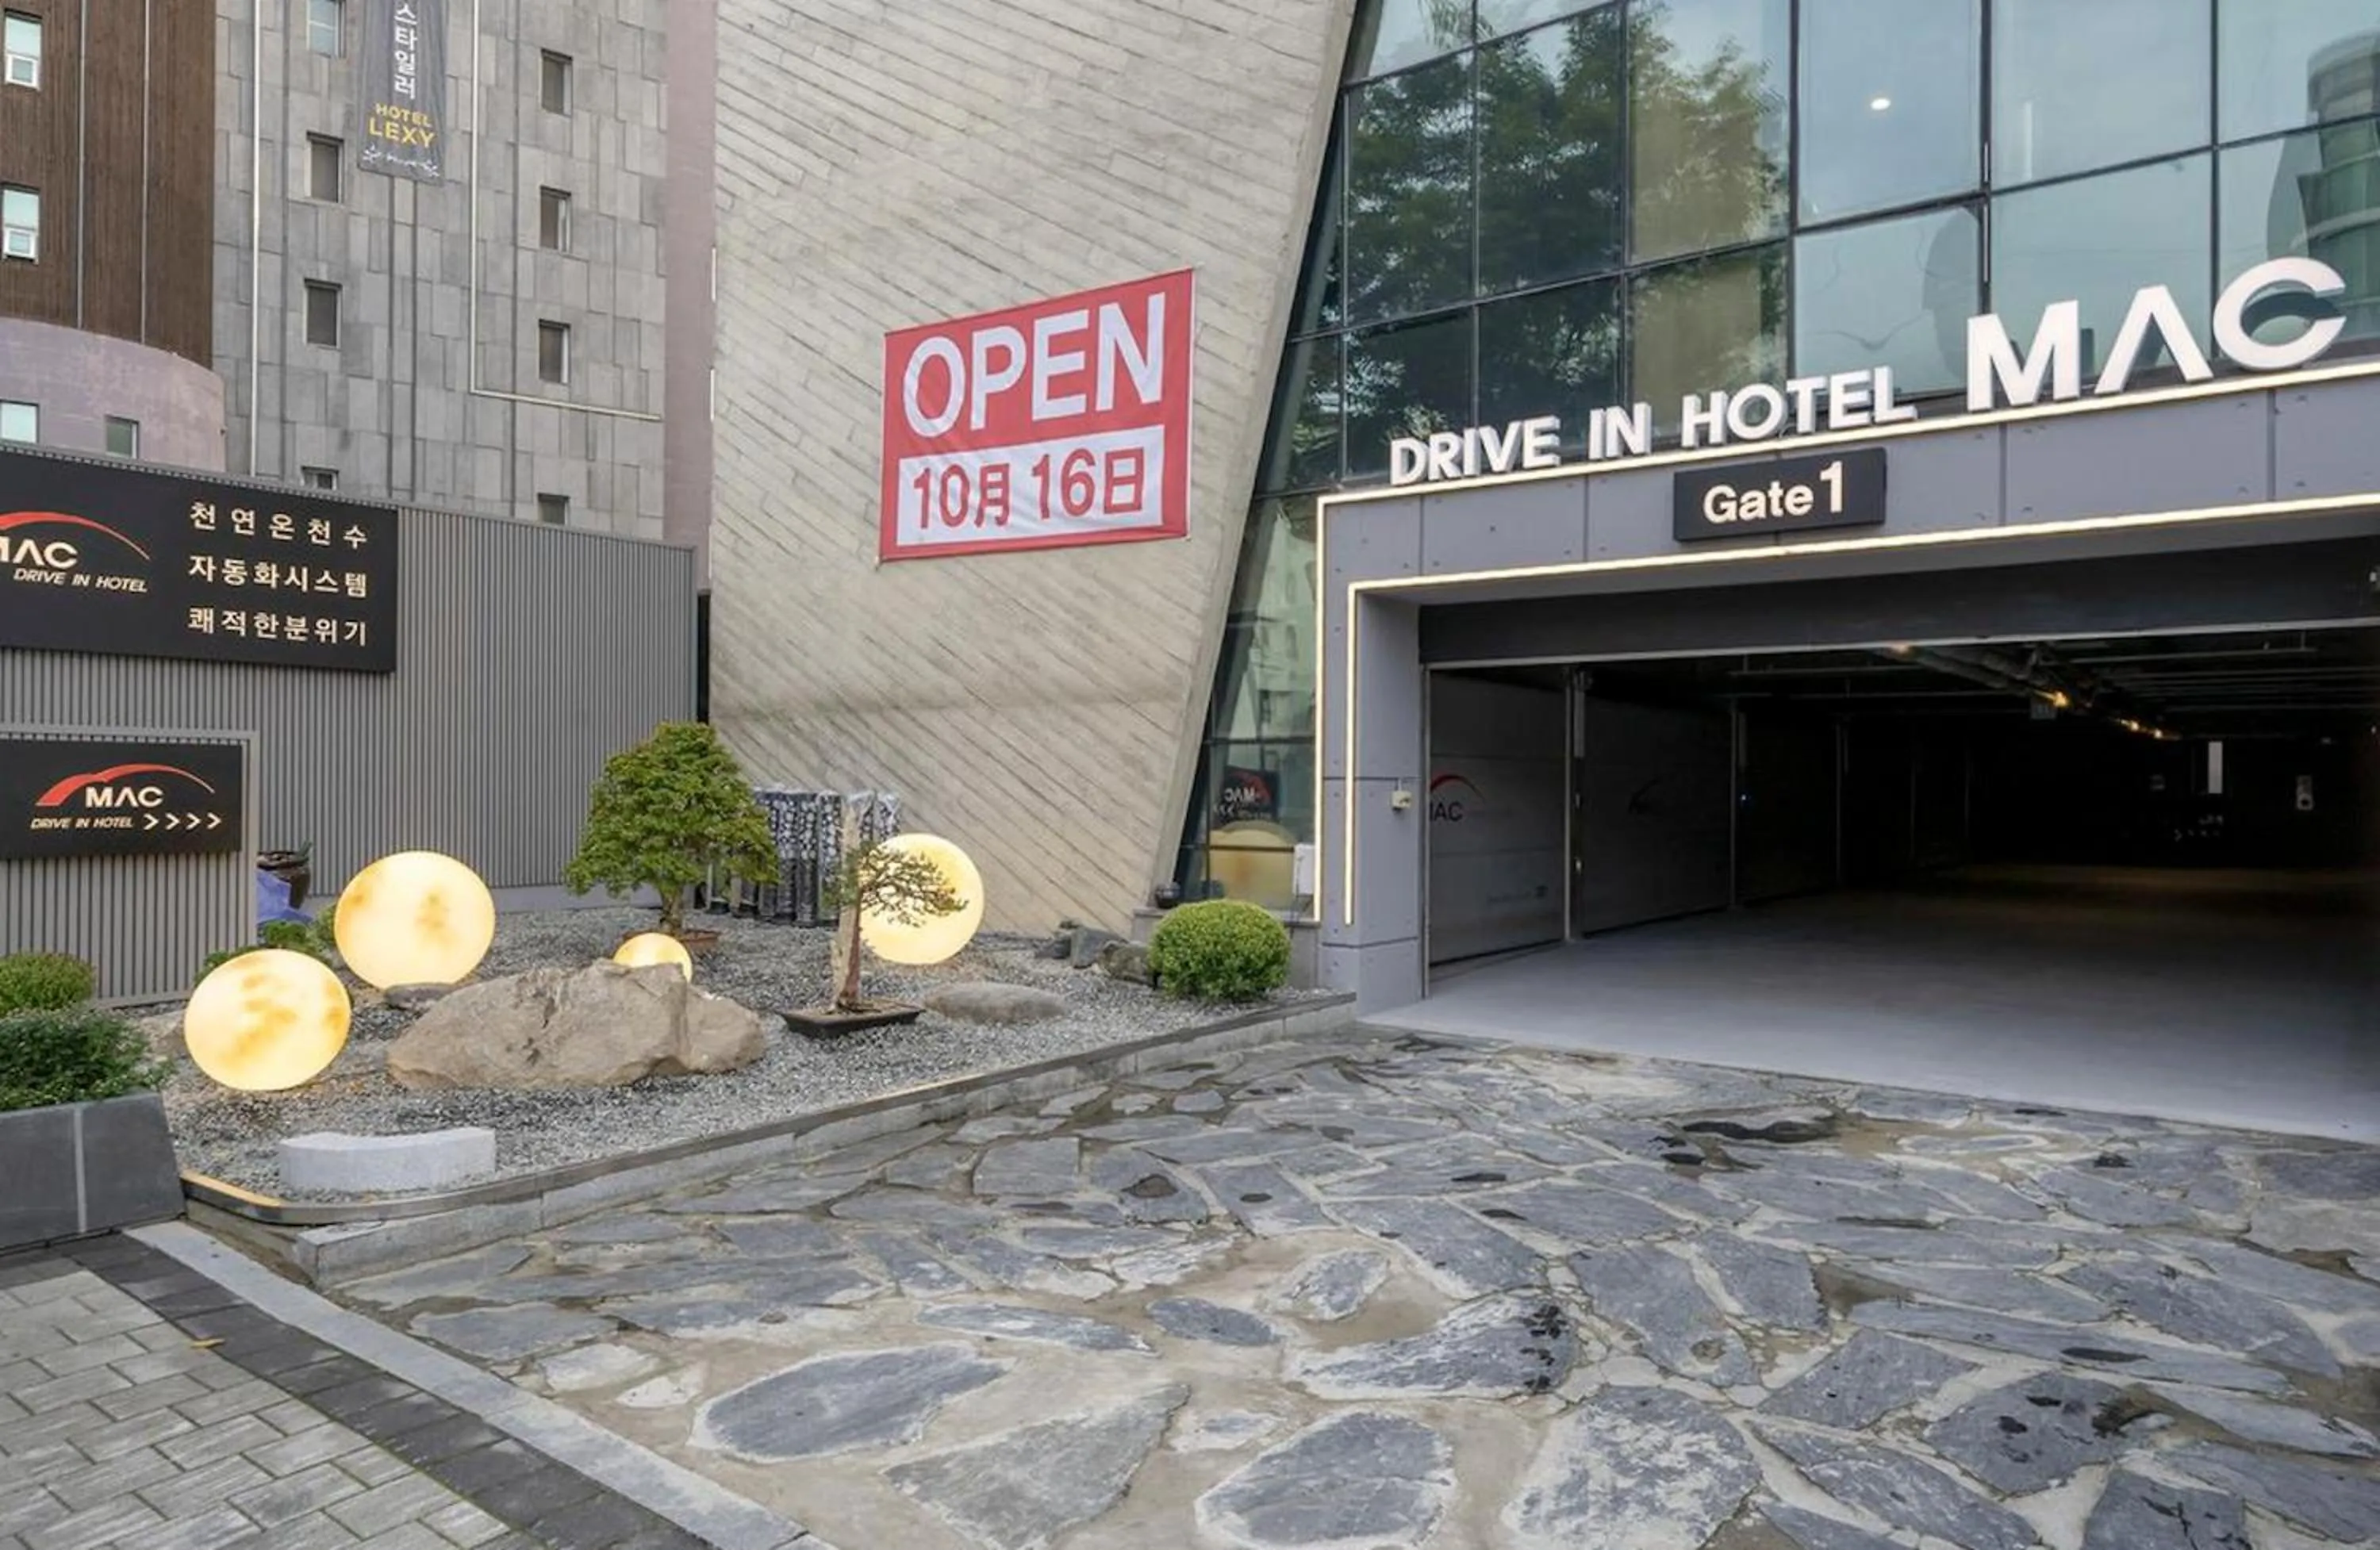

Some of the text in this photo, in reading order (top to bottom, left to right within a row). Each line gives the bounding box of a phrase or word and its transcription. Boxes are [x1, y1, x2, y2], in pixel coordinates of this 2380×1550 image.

[393, 2, 418, 100] 스타일러
[368, 117, 435, 149] LEXY
[374, 102, 432, 128] HOTEL
[903, 291, 1166, 438] OPEN
[1390, 256, 2347, 486] DRIVE IN HOTEL MAC
[913, 447, 1145, 530] 10月 16日
[13, 567, 148, 593] DRIVE IN HOTEL
[188, 554, 368, 598] 자동화시스템
[187, 606, 368, 647] 쾌적한분위기
[85, 786, 164, 808] MAC
[1430, 800, 1464, 823] AC
[30, 815, 134, 830] DRIVE IN HOTEL
